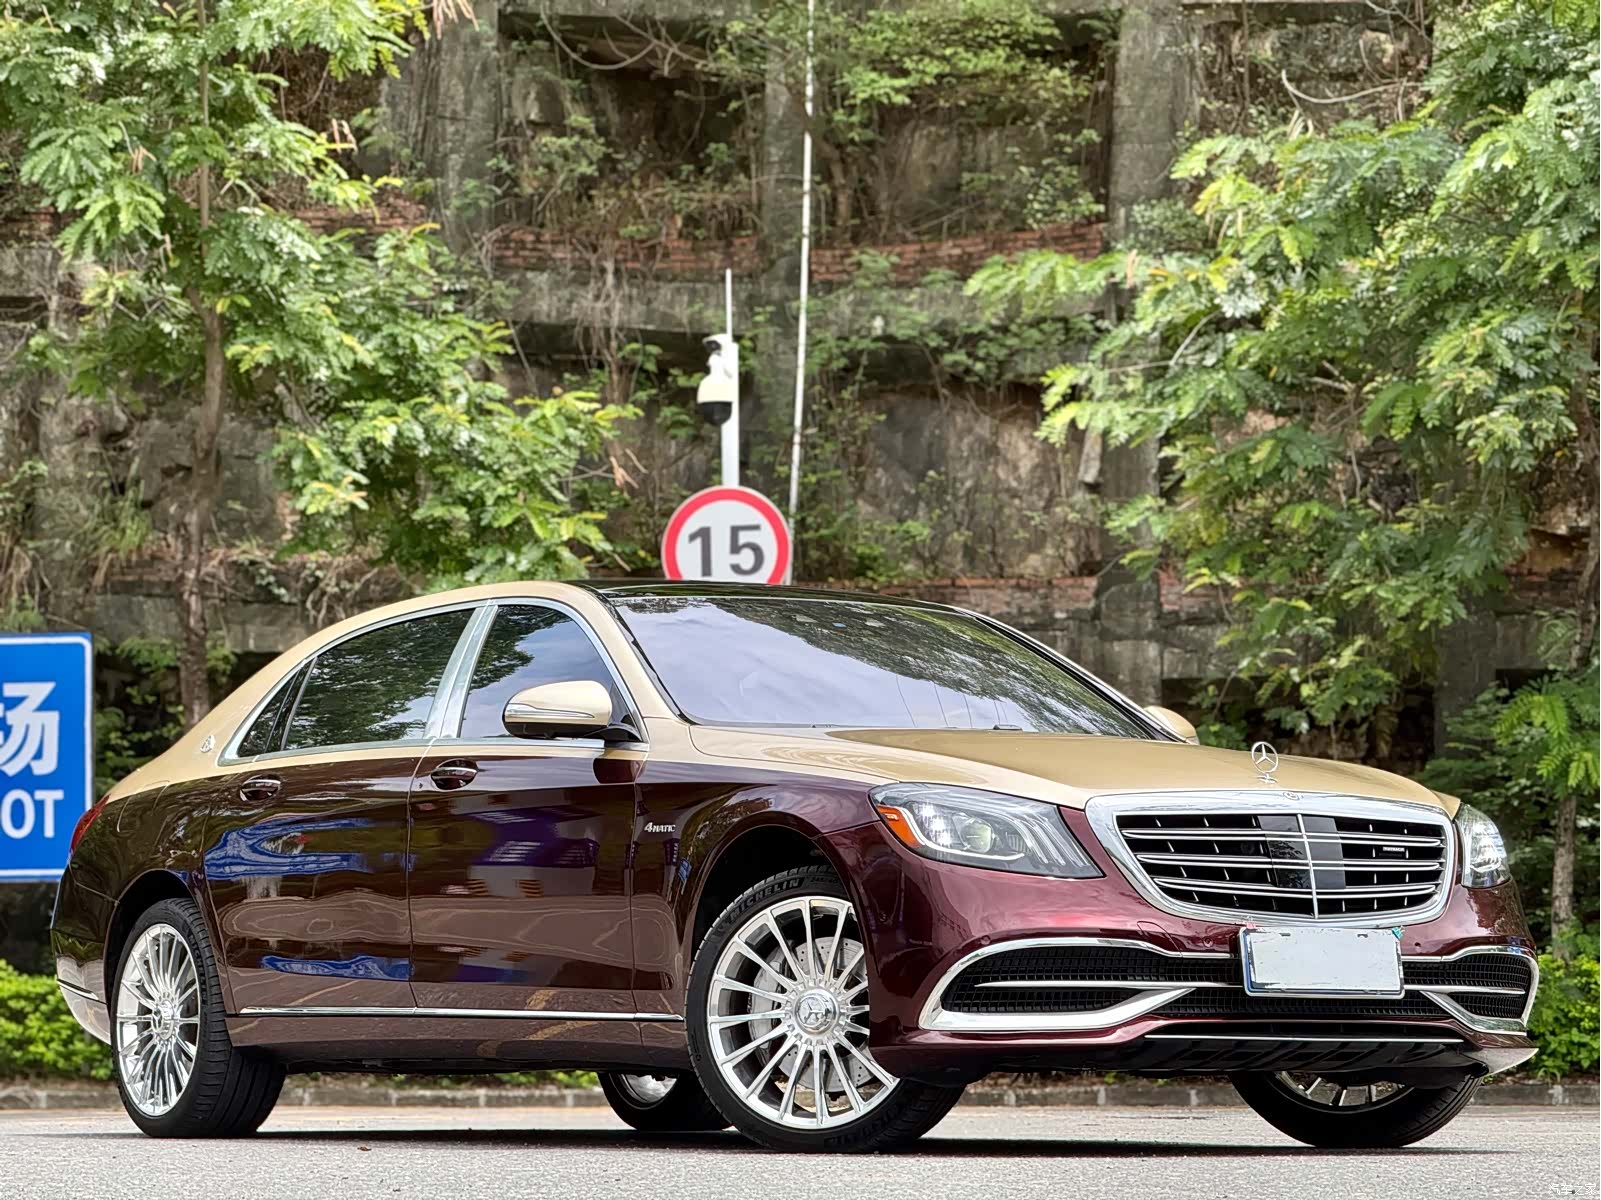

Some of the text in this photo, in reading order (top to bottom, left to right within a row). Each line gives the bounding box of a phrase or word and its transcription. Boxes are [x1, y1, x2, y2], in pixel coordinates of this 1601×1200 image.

[688, 525, 765, 577] 15
[644, 822, 676, 833] 4MATIC
[729, 878, 801, 921] MICHELIN
